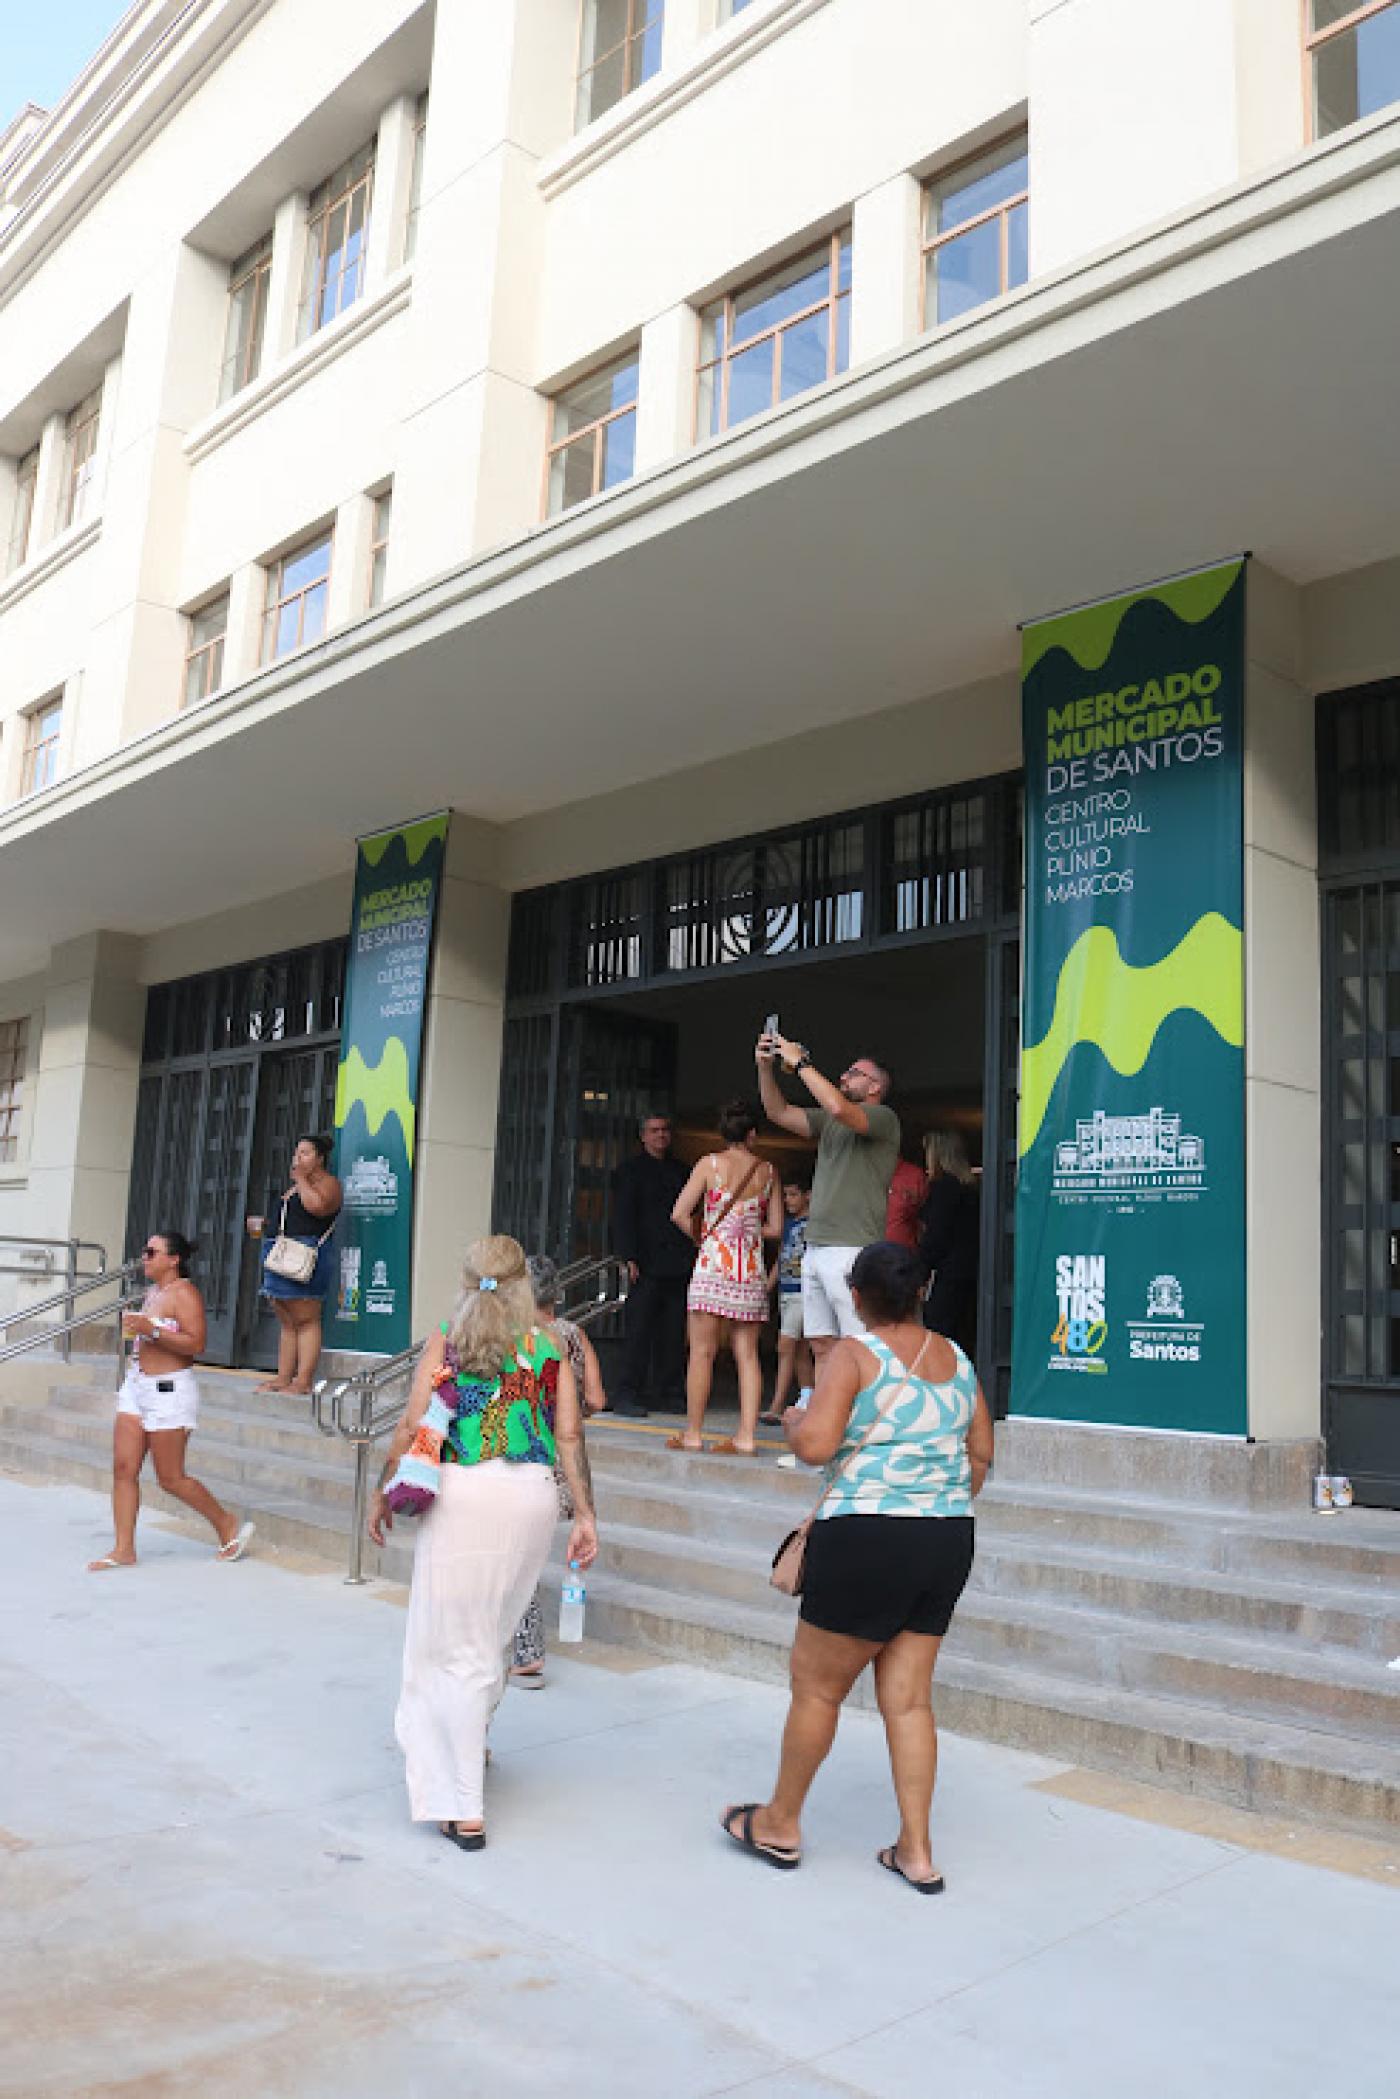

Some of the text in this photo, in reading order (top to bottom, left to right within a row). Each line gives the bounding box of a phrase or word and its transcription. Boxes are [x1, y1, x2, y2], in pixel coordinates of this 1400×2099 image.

[1048, 664, 1222, 736] MERCADO
[1048, 698, 1222, 764] MUNICIPAL
[1047, 727, 1224, 795] DE SANTOS
[1045, 788, 1131, 825] CENTRO
[1045, 812, 1151, 852] CULTURAL
[361, 878, 432, 912] MERCADO
[1046, 869, 1134, 904] MARCOS
[375, 918, 427, 946] SANTOS
[1055, 1254, 1106, 1288] SAN
[1055, 1288, 1106, 1324] TOS
[1050, 1312, 1109, 1356] 480
[1129, 1340, 1202, 1361] Santos
